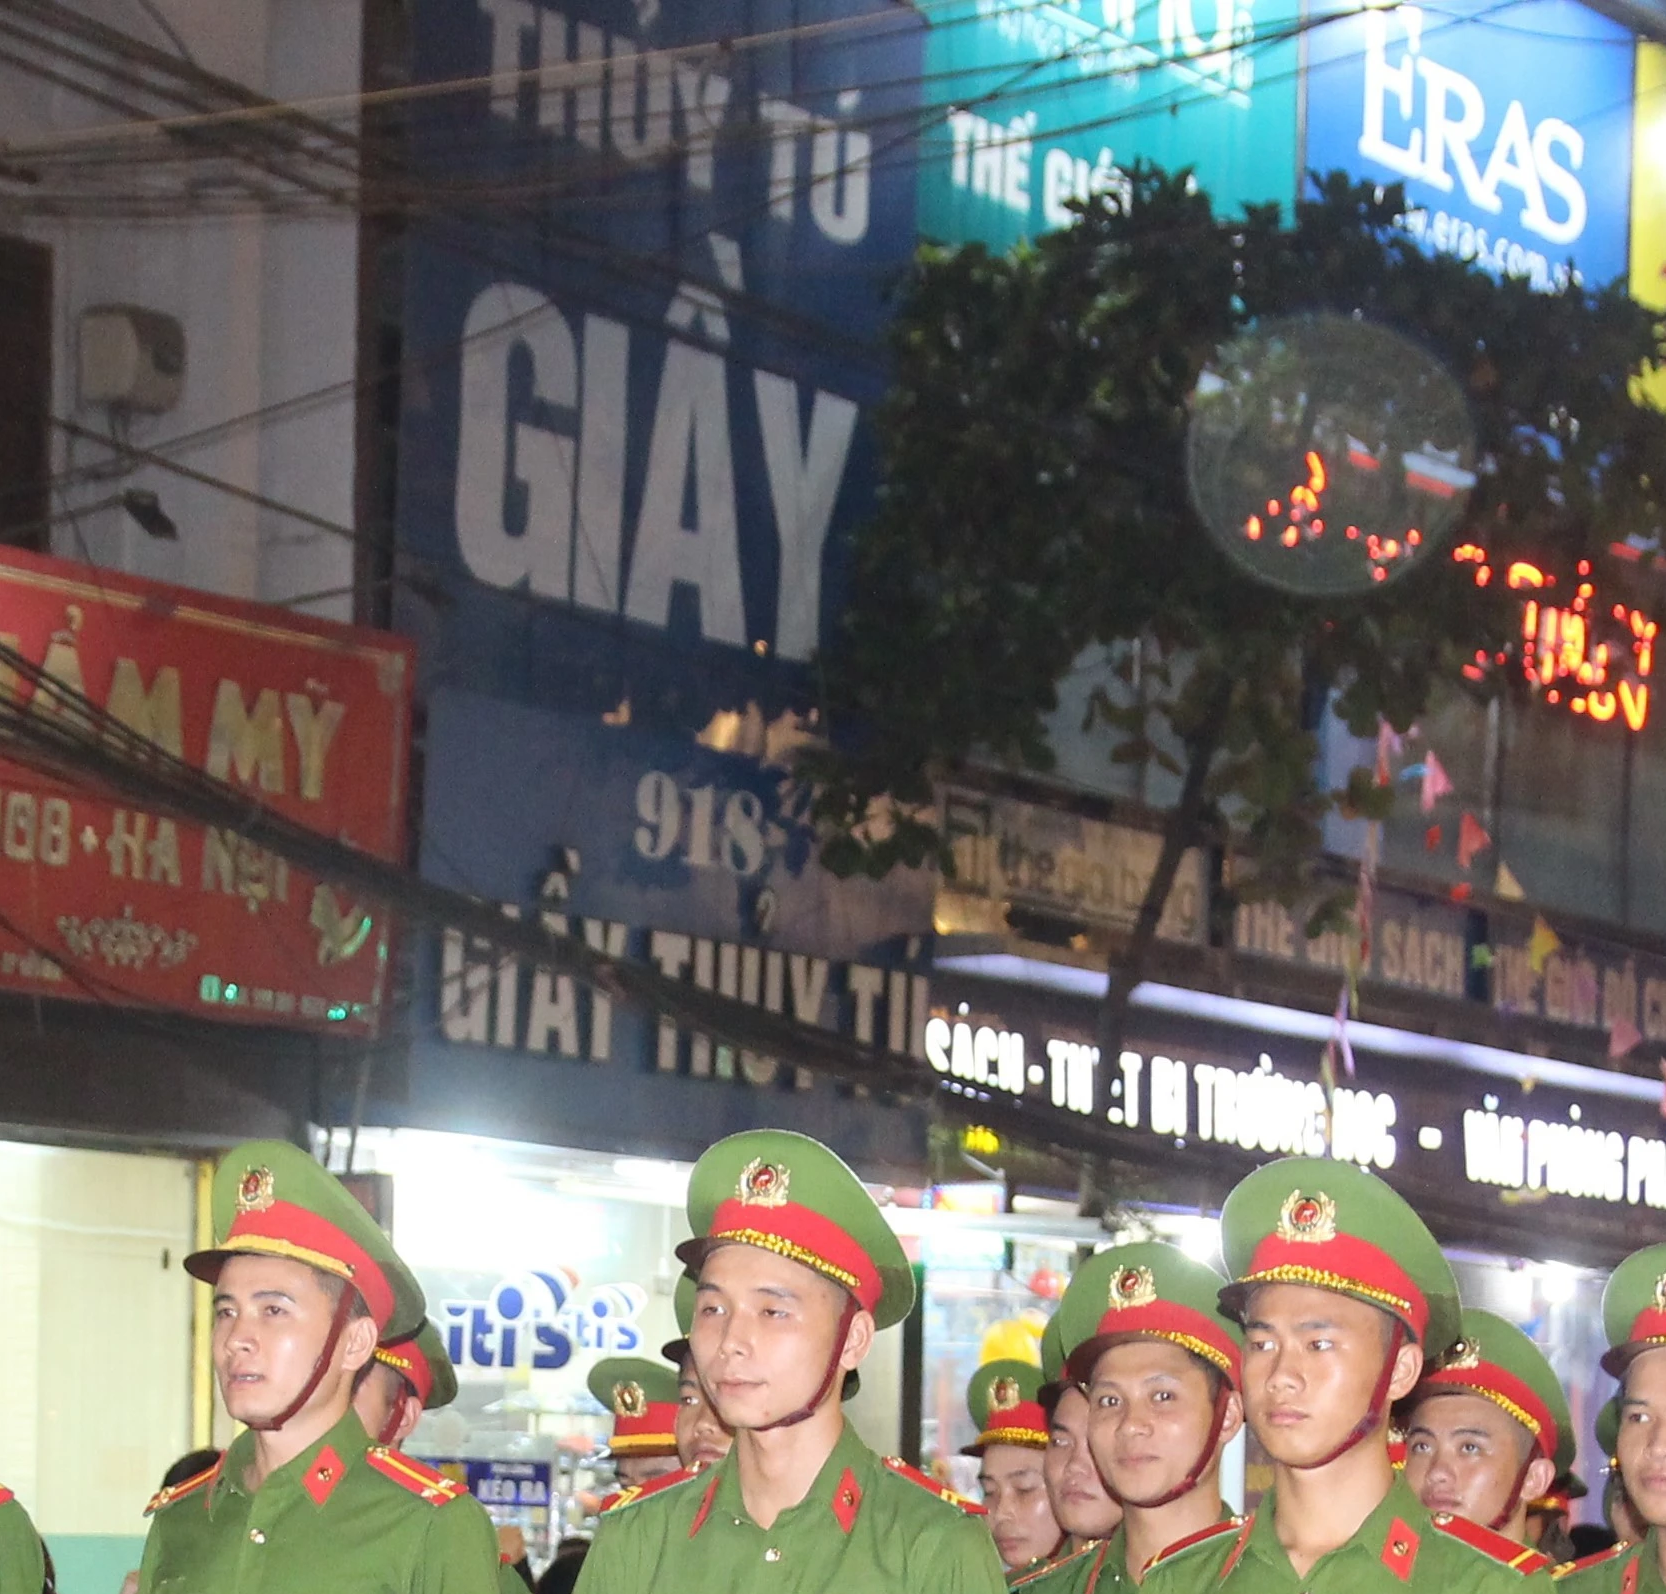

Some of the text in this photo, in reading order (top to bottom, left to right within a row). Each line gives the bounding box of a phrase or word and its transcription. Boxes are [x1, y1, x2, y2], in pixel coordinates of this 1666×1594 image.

[759, 88, 872, 245] TÚ
[1358, 5, 1588, 244] ERAS
[454, 231, 859, 663] GIẦY
[635, 768, 764, 876] 918
